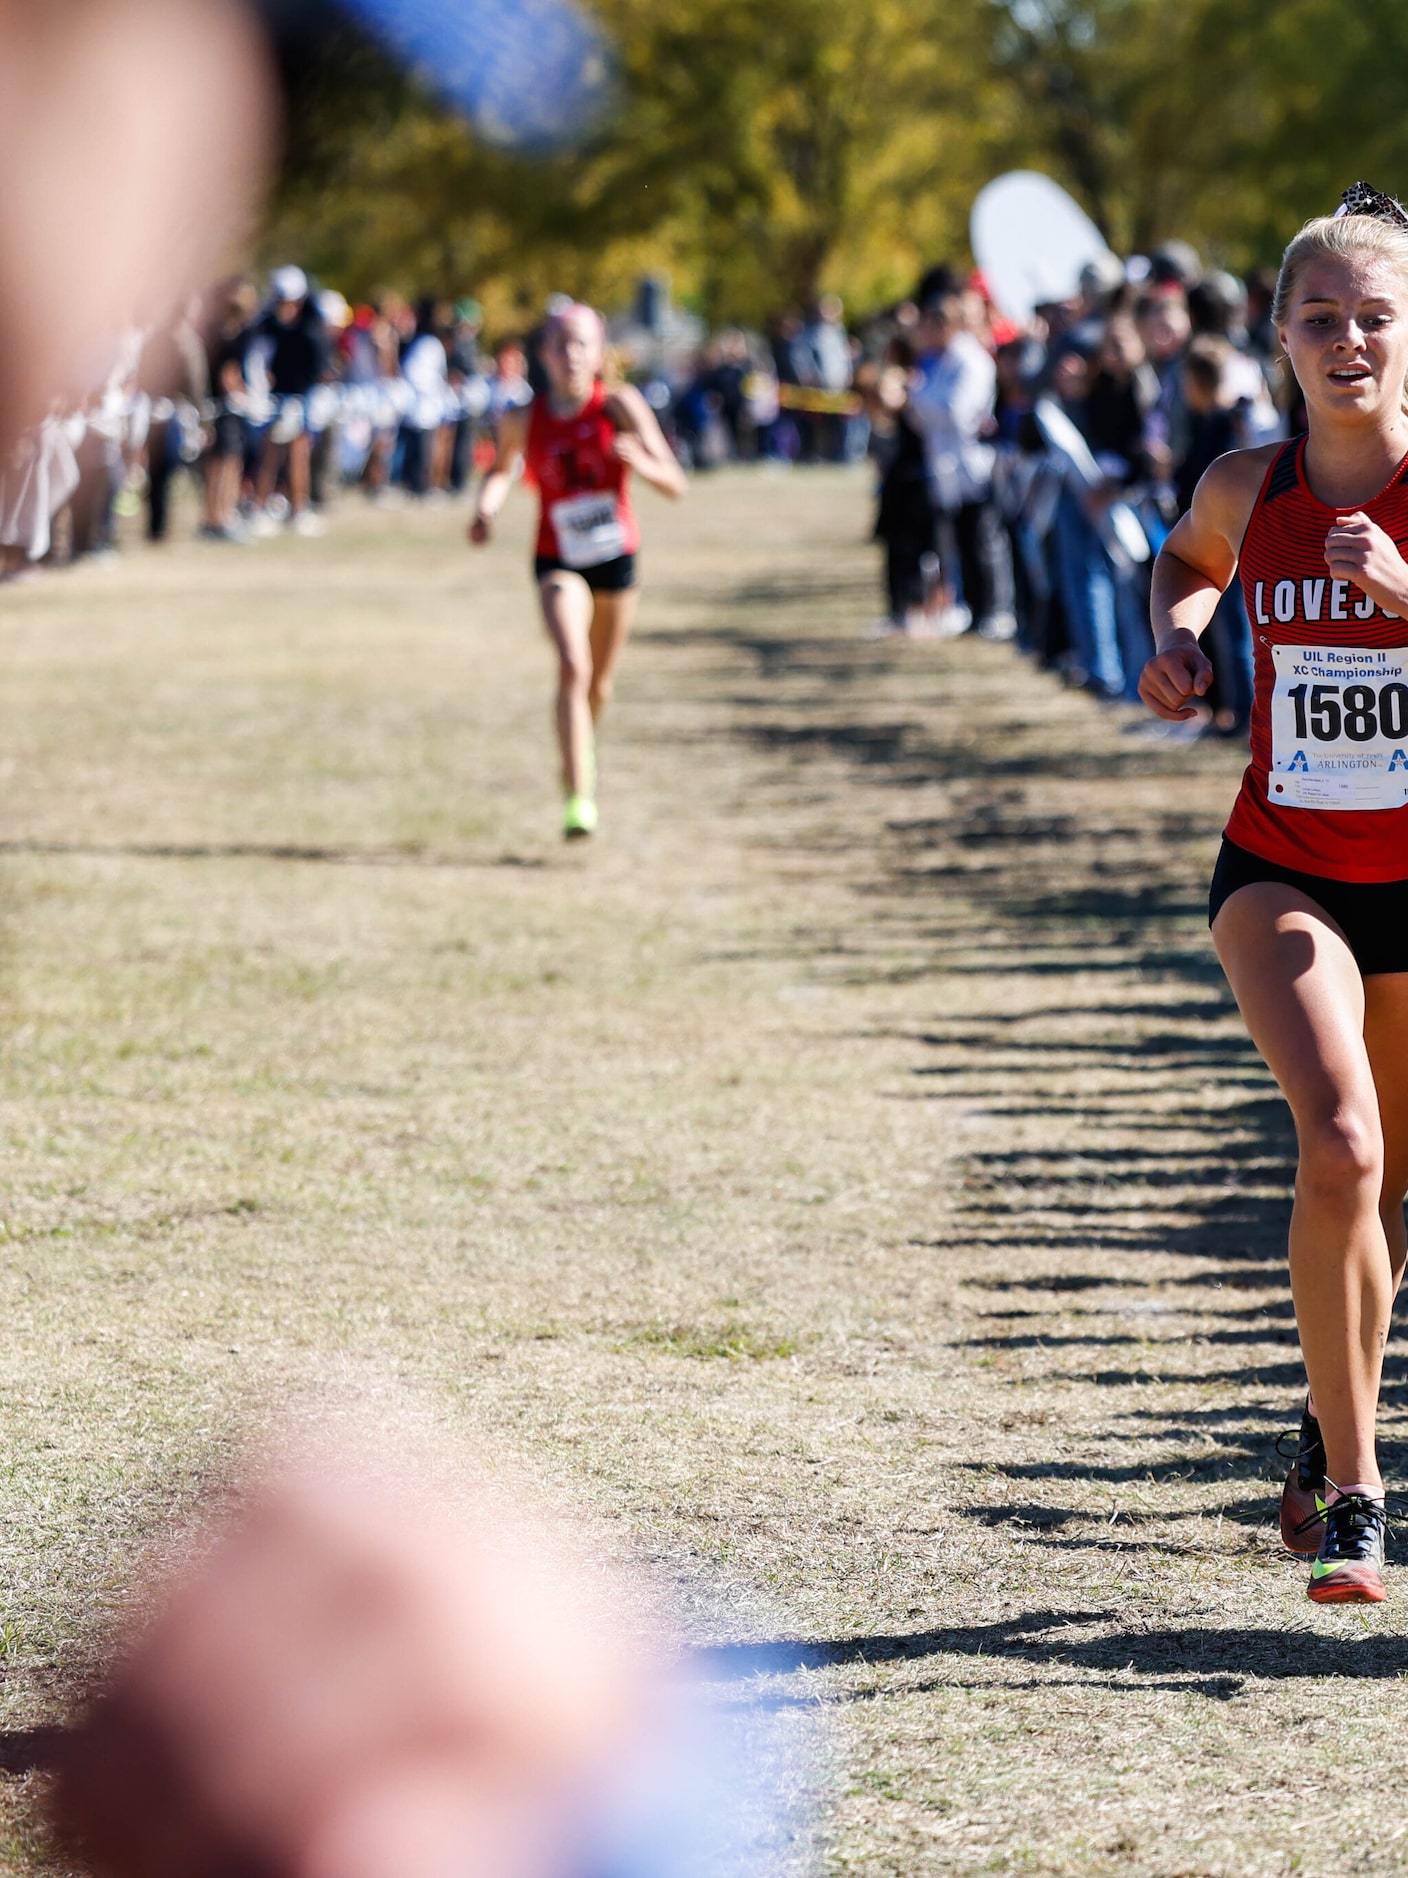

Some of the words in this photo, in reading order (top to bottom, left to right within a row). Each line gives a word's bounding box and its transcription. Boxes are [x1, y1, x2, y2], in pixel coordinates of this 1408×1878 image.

[1303, 651, 1323, 662] UIL
[1327, 652, 1373, 665] Region
[1377, 652, 1387, 663] II
[1293, 665, 1309, 676] XC
[1311, 666, 1402, 680] Championship
[1317, 759, 1377, 769] ARLINGTON
